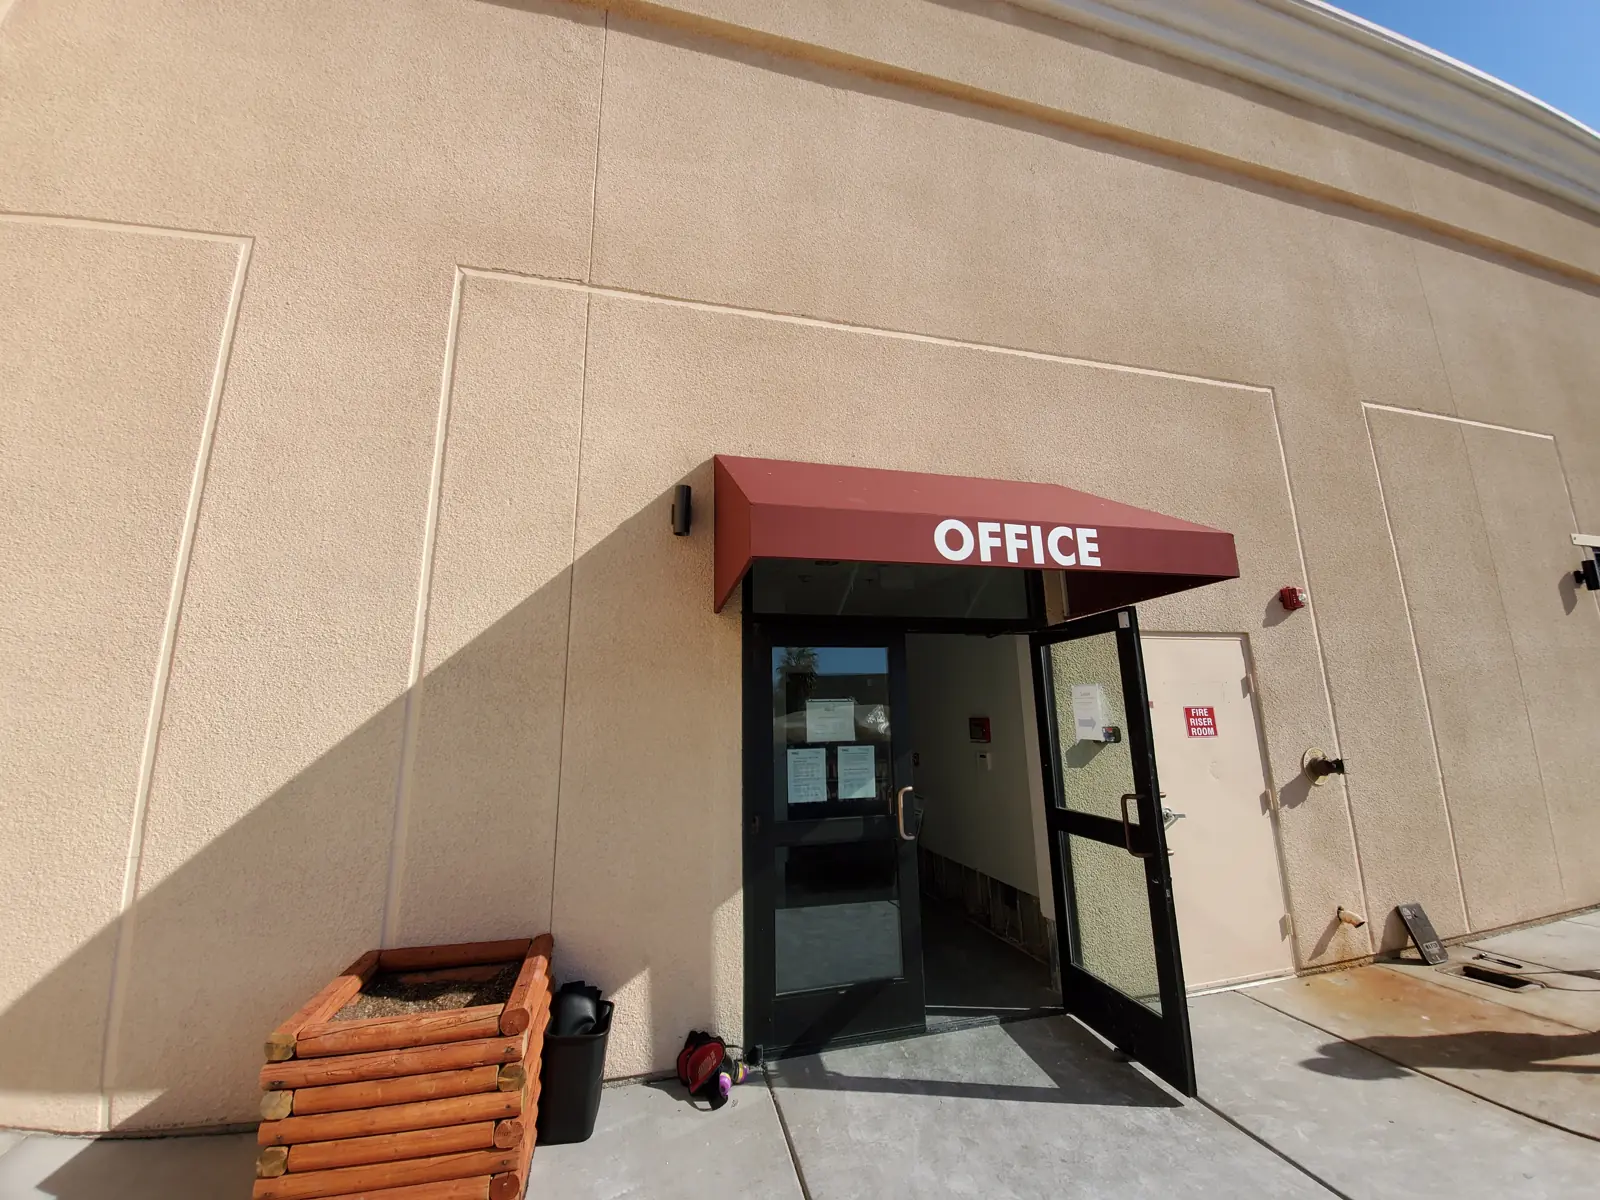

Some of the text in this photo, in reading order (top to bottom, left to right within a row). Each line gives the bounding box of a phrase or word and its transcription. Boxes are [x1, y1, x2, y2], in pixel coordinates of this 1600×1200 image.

[934, 518, 1101, 567] OFFICE
[1191, 708, 1209, 717] FIRE
[1190, 718, 1213, 726] RISER
[1191, 727, 1215, 736] ROOM
